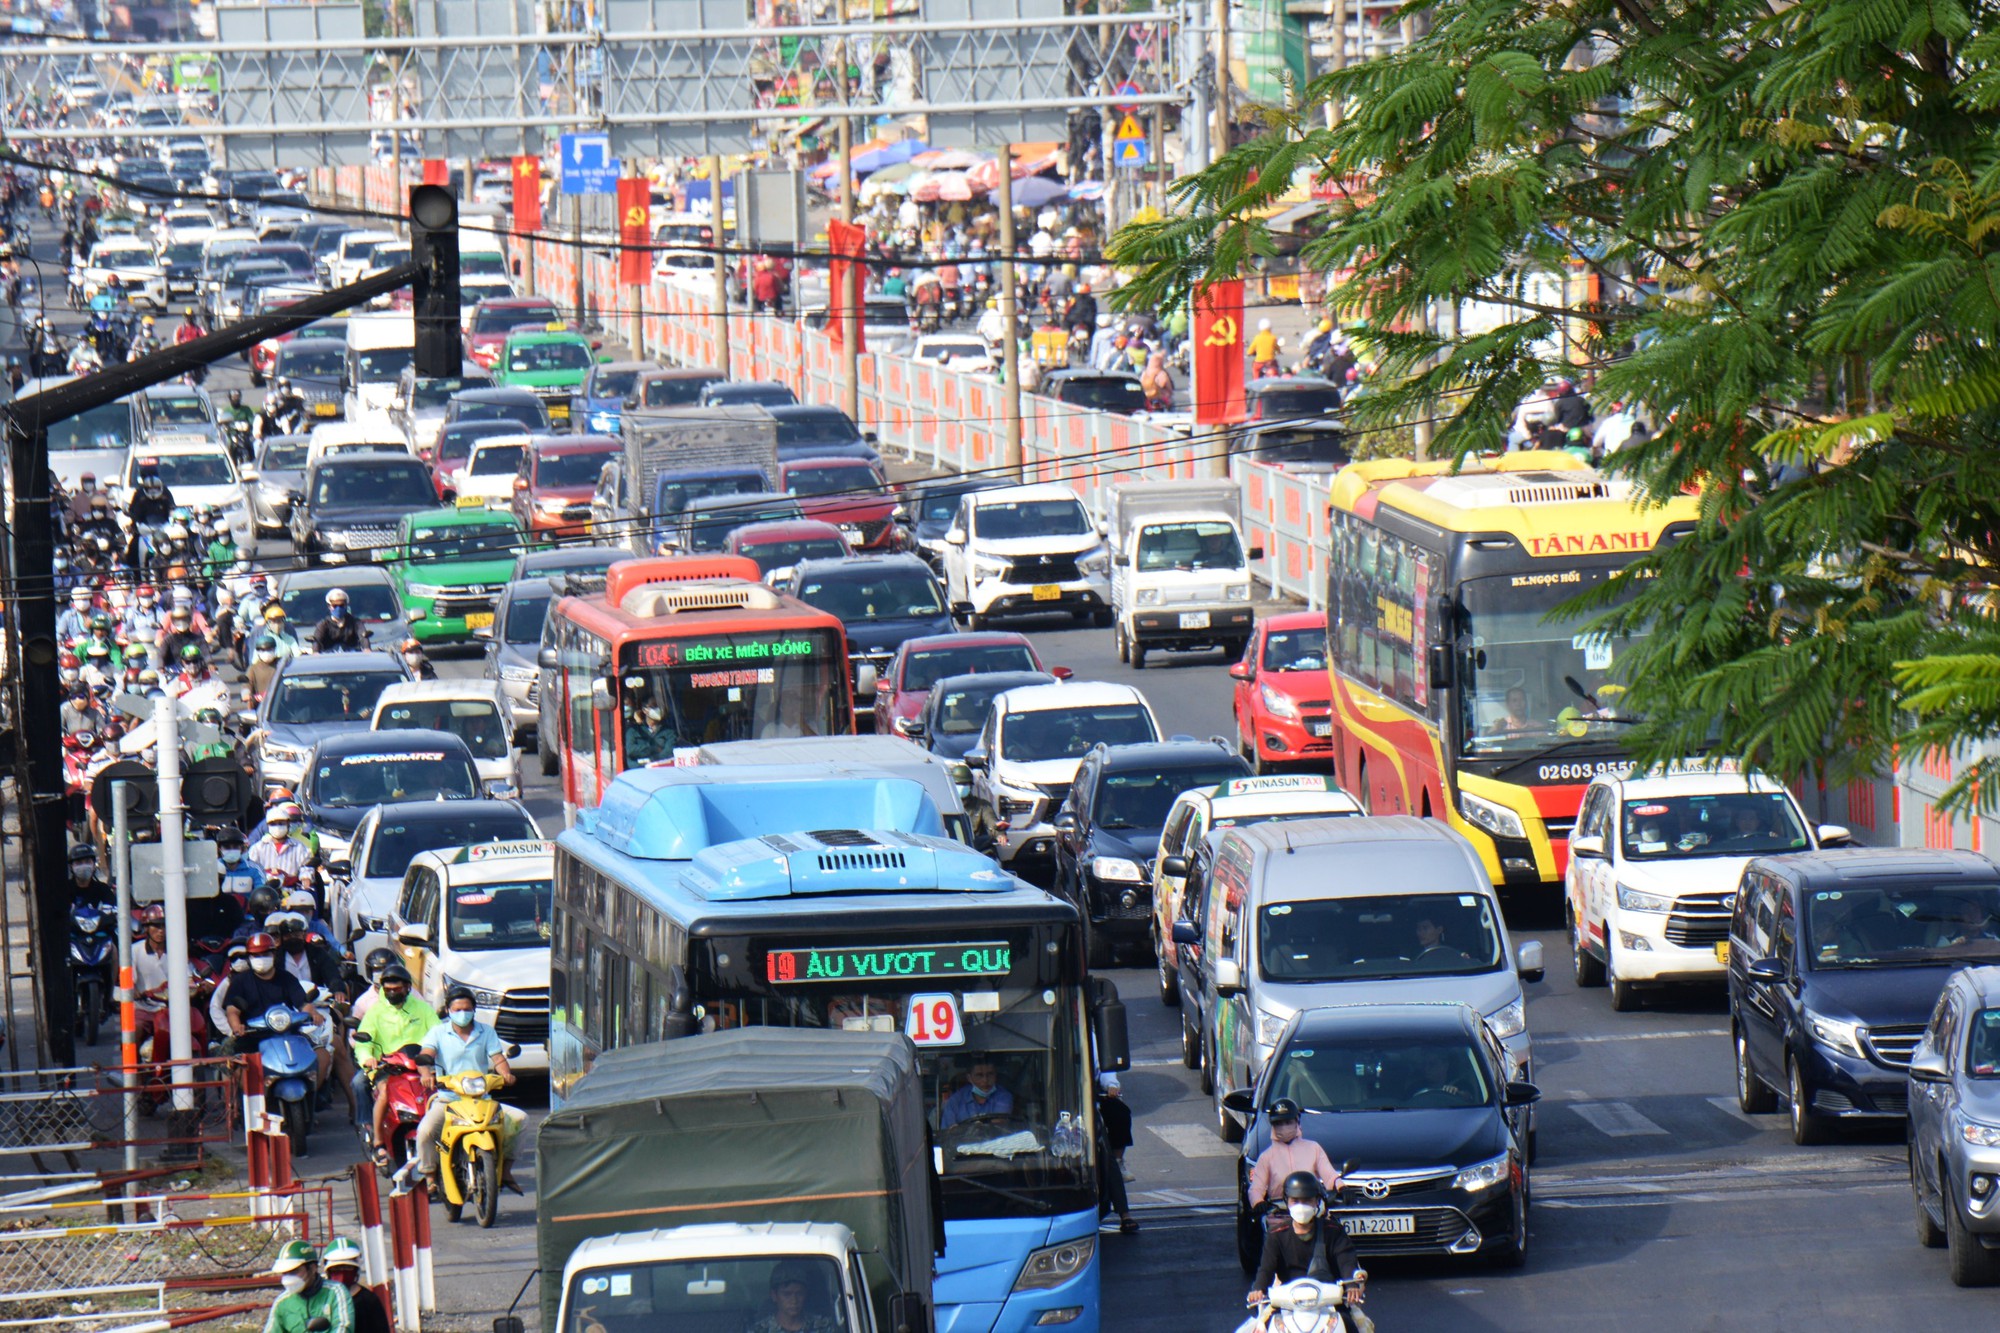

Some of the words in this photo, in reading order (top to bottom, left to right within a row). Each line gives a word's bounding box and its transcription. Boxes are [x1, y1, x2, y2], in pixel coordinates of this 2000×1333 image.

[1529, 532, 1584, 555] TÂN
[1589, 531, 1650, 552] ANH
[716, 646, 733, 660] XE
[772, 639, 812, 656] ĐÔNG
[1251, 778, 1300, 789] VINASUN
[1301, 777, 1322, 786] TAXI
[491, 843, 542, 855] VINASUN
[767, 952, 796, 981] 19
[912, 1000, 955, 1041] 19
[1343, 1217, 1410, 1235] 61A-220.11
